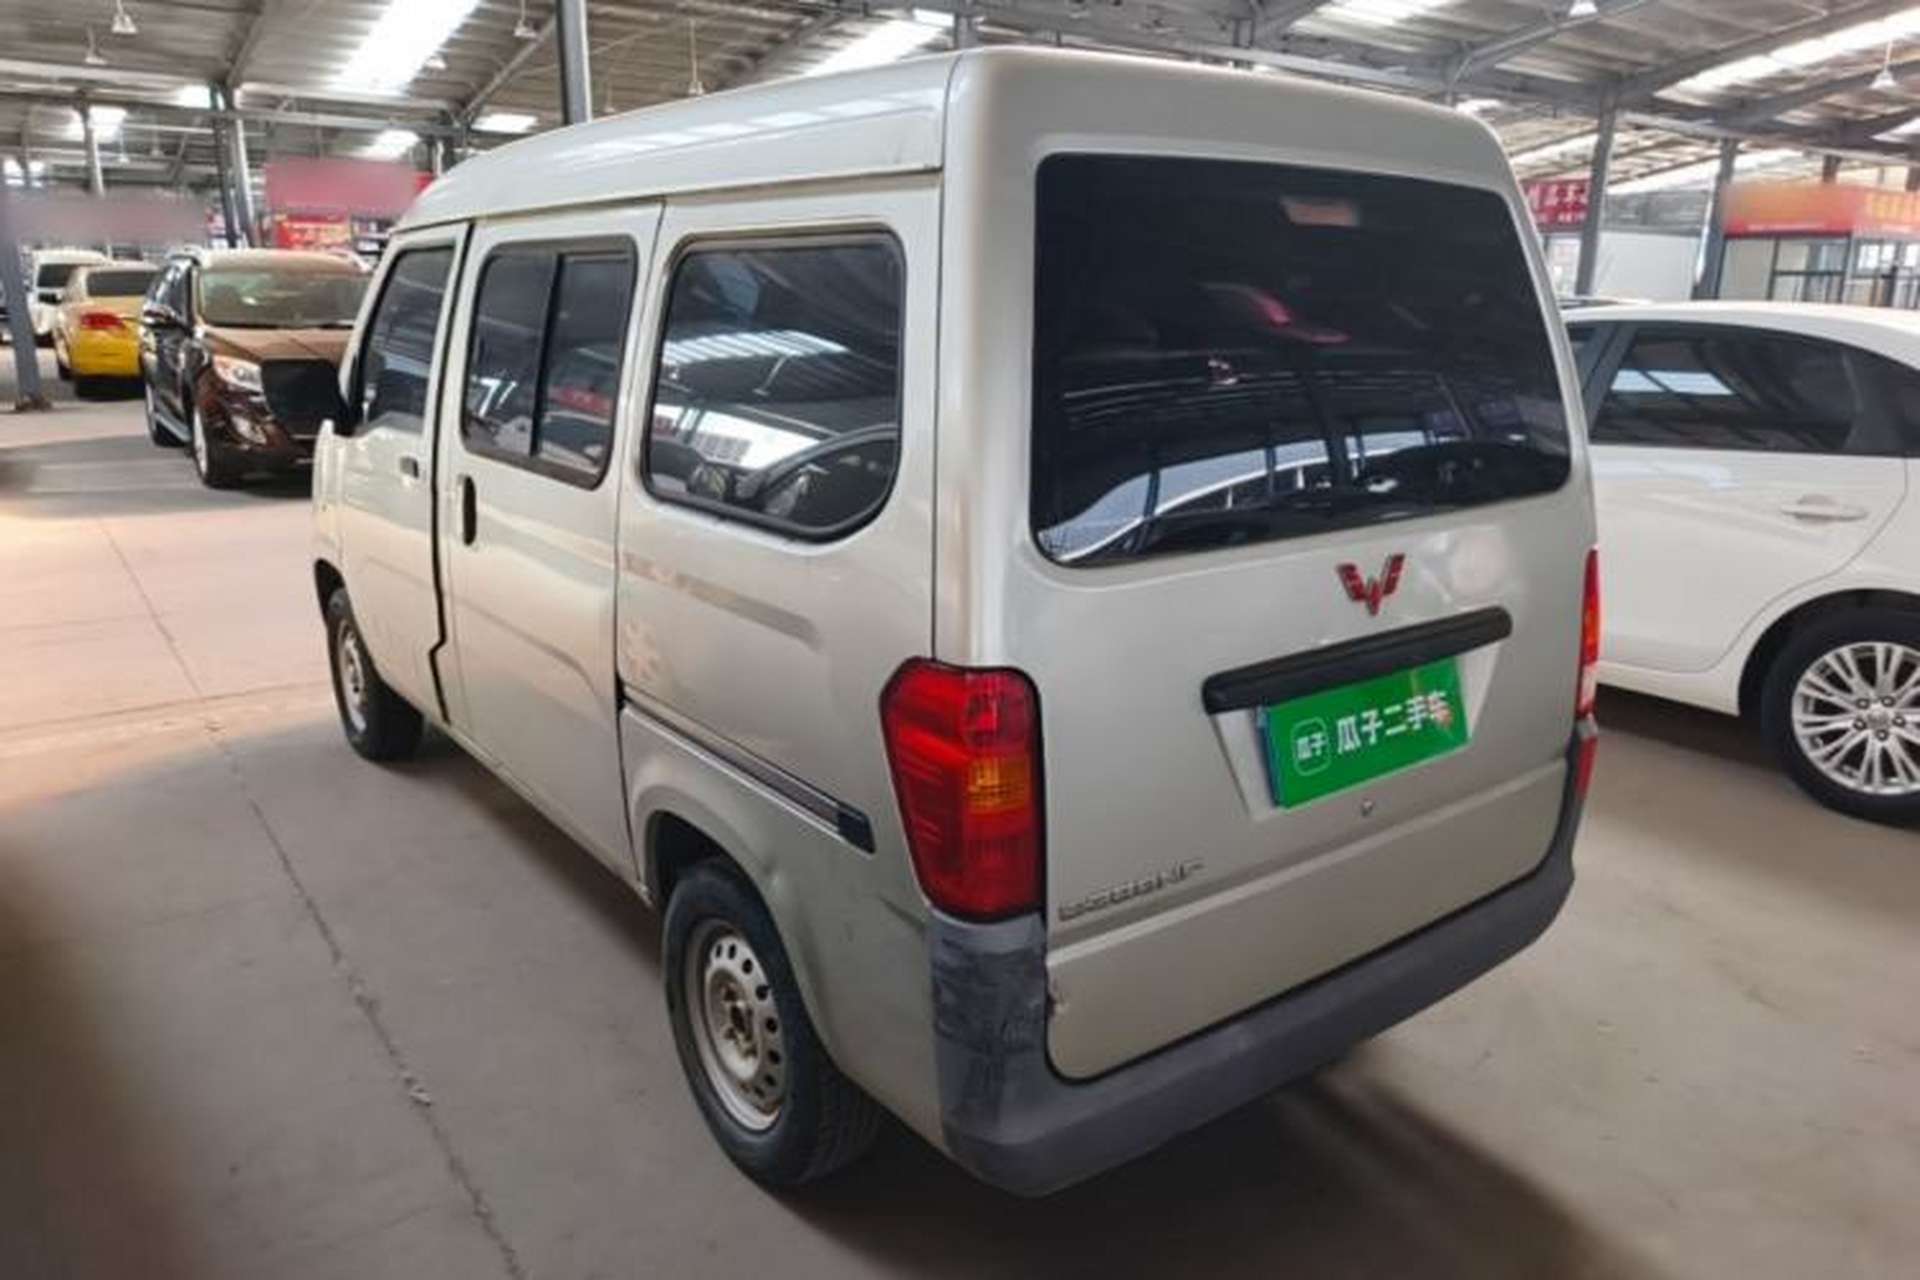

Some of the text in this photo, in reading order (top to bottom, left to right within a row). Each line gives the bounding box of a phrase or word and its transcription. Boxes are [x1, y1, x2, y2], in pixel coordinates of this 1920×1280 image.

[1336, 690, 1451, 754] 瓜子二手车
